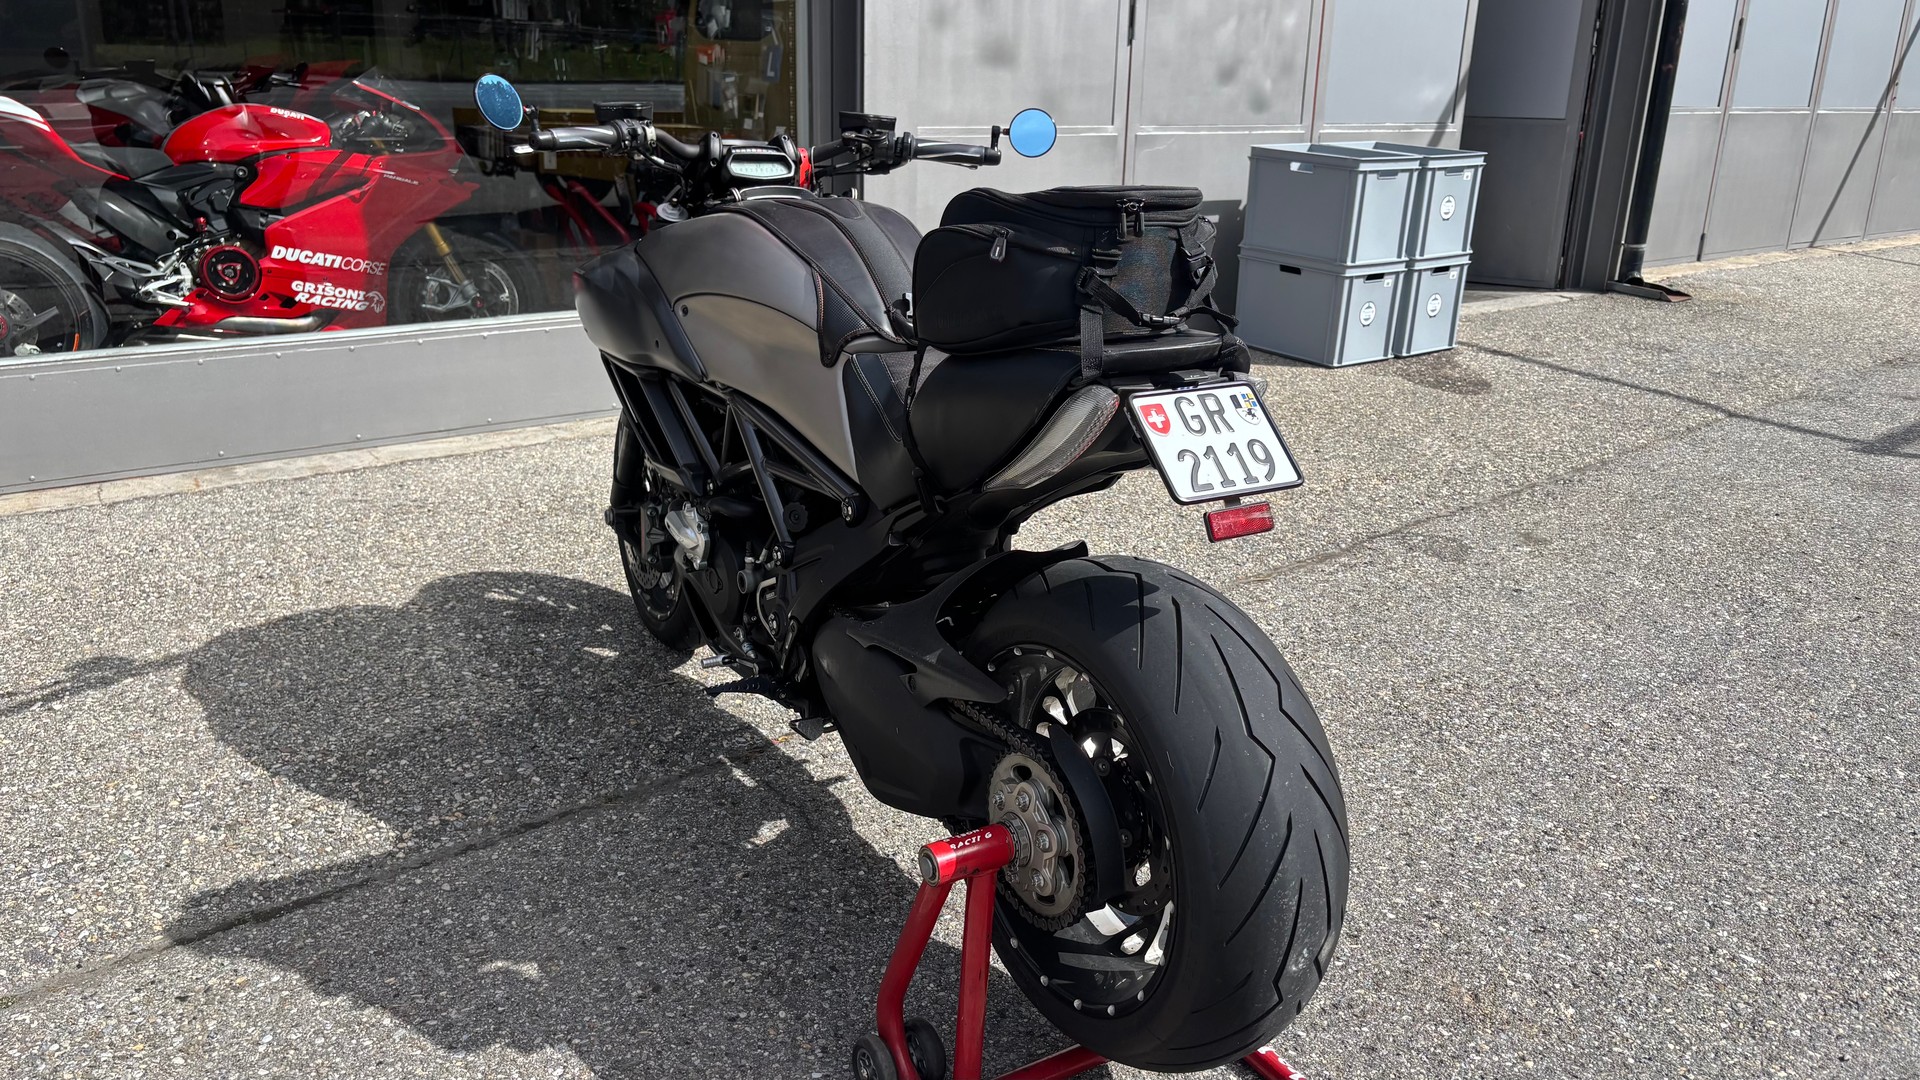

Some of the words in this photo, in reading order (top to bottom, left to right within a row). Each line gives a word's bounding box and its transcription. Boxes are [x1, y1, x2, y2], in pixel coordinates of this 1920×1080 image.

[270, 107, 305, 121] DUCATI
[291, 280, 366, 300] GRISONI
[294, 292, 369, 311] RACING
[1174, 393, 1235, 436] GR
[1177, 438, 1276, 492] 2119
